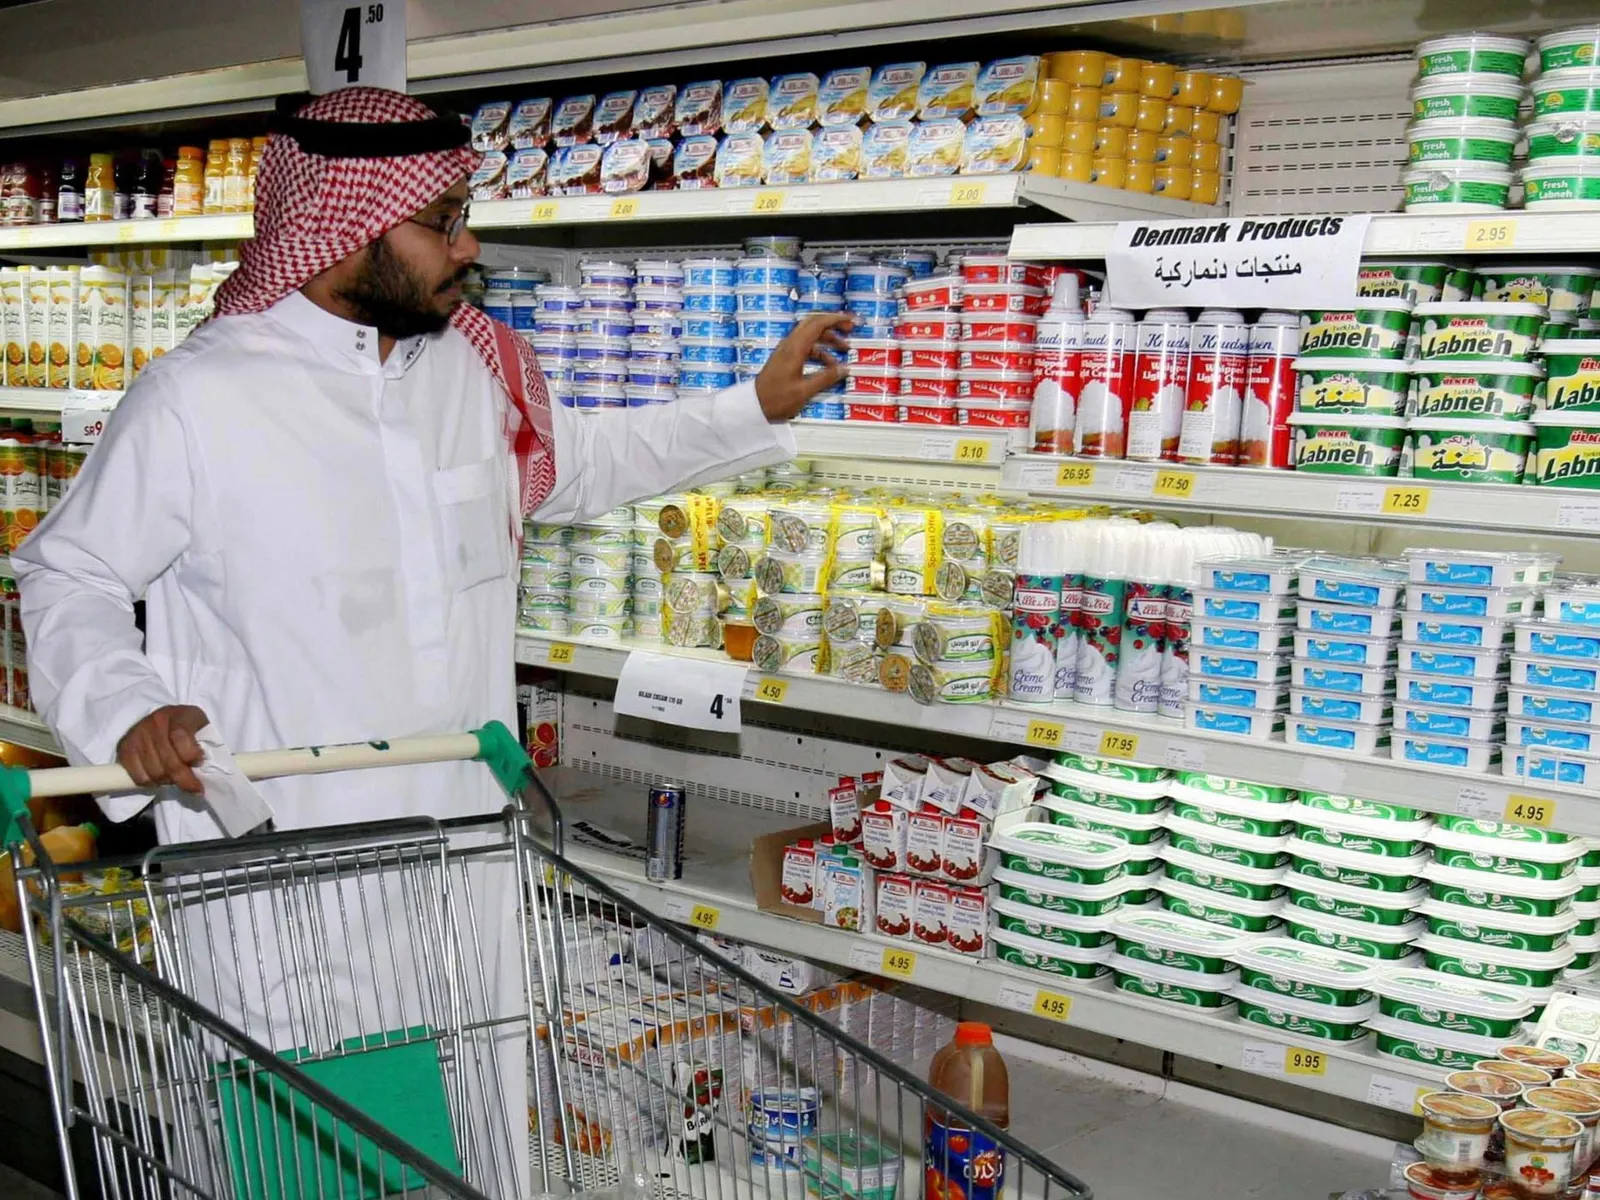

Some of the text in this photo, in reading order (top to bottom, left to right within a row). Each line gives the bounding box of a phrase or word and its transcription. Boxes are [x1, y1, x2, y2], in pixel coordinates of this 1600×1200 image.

[1430, 55, 1453, 64] Fresh
[1428, 64, 1457, 74] Labneh
[1427, 99, 1450, 108] Fresh
[1424, 108, 1455, 118] Labneh
[1419, 150, 1450, 160] Labneh
[1413, 184, 1433, 193] Fres
[1543, 180, 1568, 189] Fresh
[957, 189, 979, 200] 2.00
[1411, 194, 1439, 203] Labneh
[1539, 189, 1573, 199] Labneh
[757, 199, 778, 209] 2.00
[1129, 216, 1344, 248] Denmark Products
[1476, 227, 1507, 241] 2.95
[1154, 254, 1302, 288] منتجات دنماركية
[1356, 283, 1418, 304] bneh
[1301, 326, 1380, 352] Labneh
[1426, 333, 1513, 357] Labneh
[1315, 383, 1371, 413] لبنة
[1421, 391, 1503, 415] Labneh
[961, 446, 983, 458] 3.10
[1298, 443, 1374, 465] Labneh
[1431, 446, 1492, 477] لبنة
[1062, 468, 1091, 480] 26.95
[1161, 477, 1189, 490] 17.50
[1393, 493, 1420, 508] 7.25
[552, 649, 569, 659] 2.25
[762, 686, 781, 698] 4.50
[1012, 681, 1043, 694] Cream
[709, 694, 724, 719] 4
[1031, 727, 1058, 741] 17.95
[1106, 737, 1133, 751] 17.95
[1513, 805, 1545, 822] 4.95
[695, 912, 713, 925] 4.95
[888, 956, 910, 970] 4.95
[1041, 999, 1065, 1014] 4.95
[1293, 1054, 1320, 1068] 9.95
